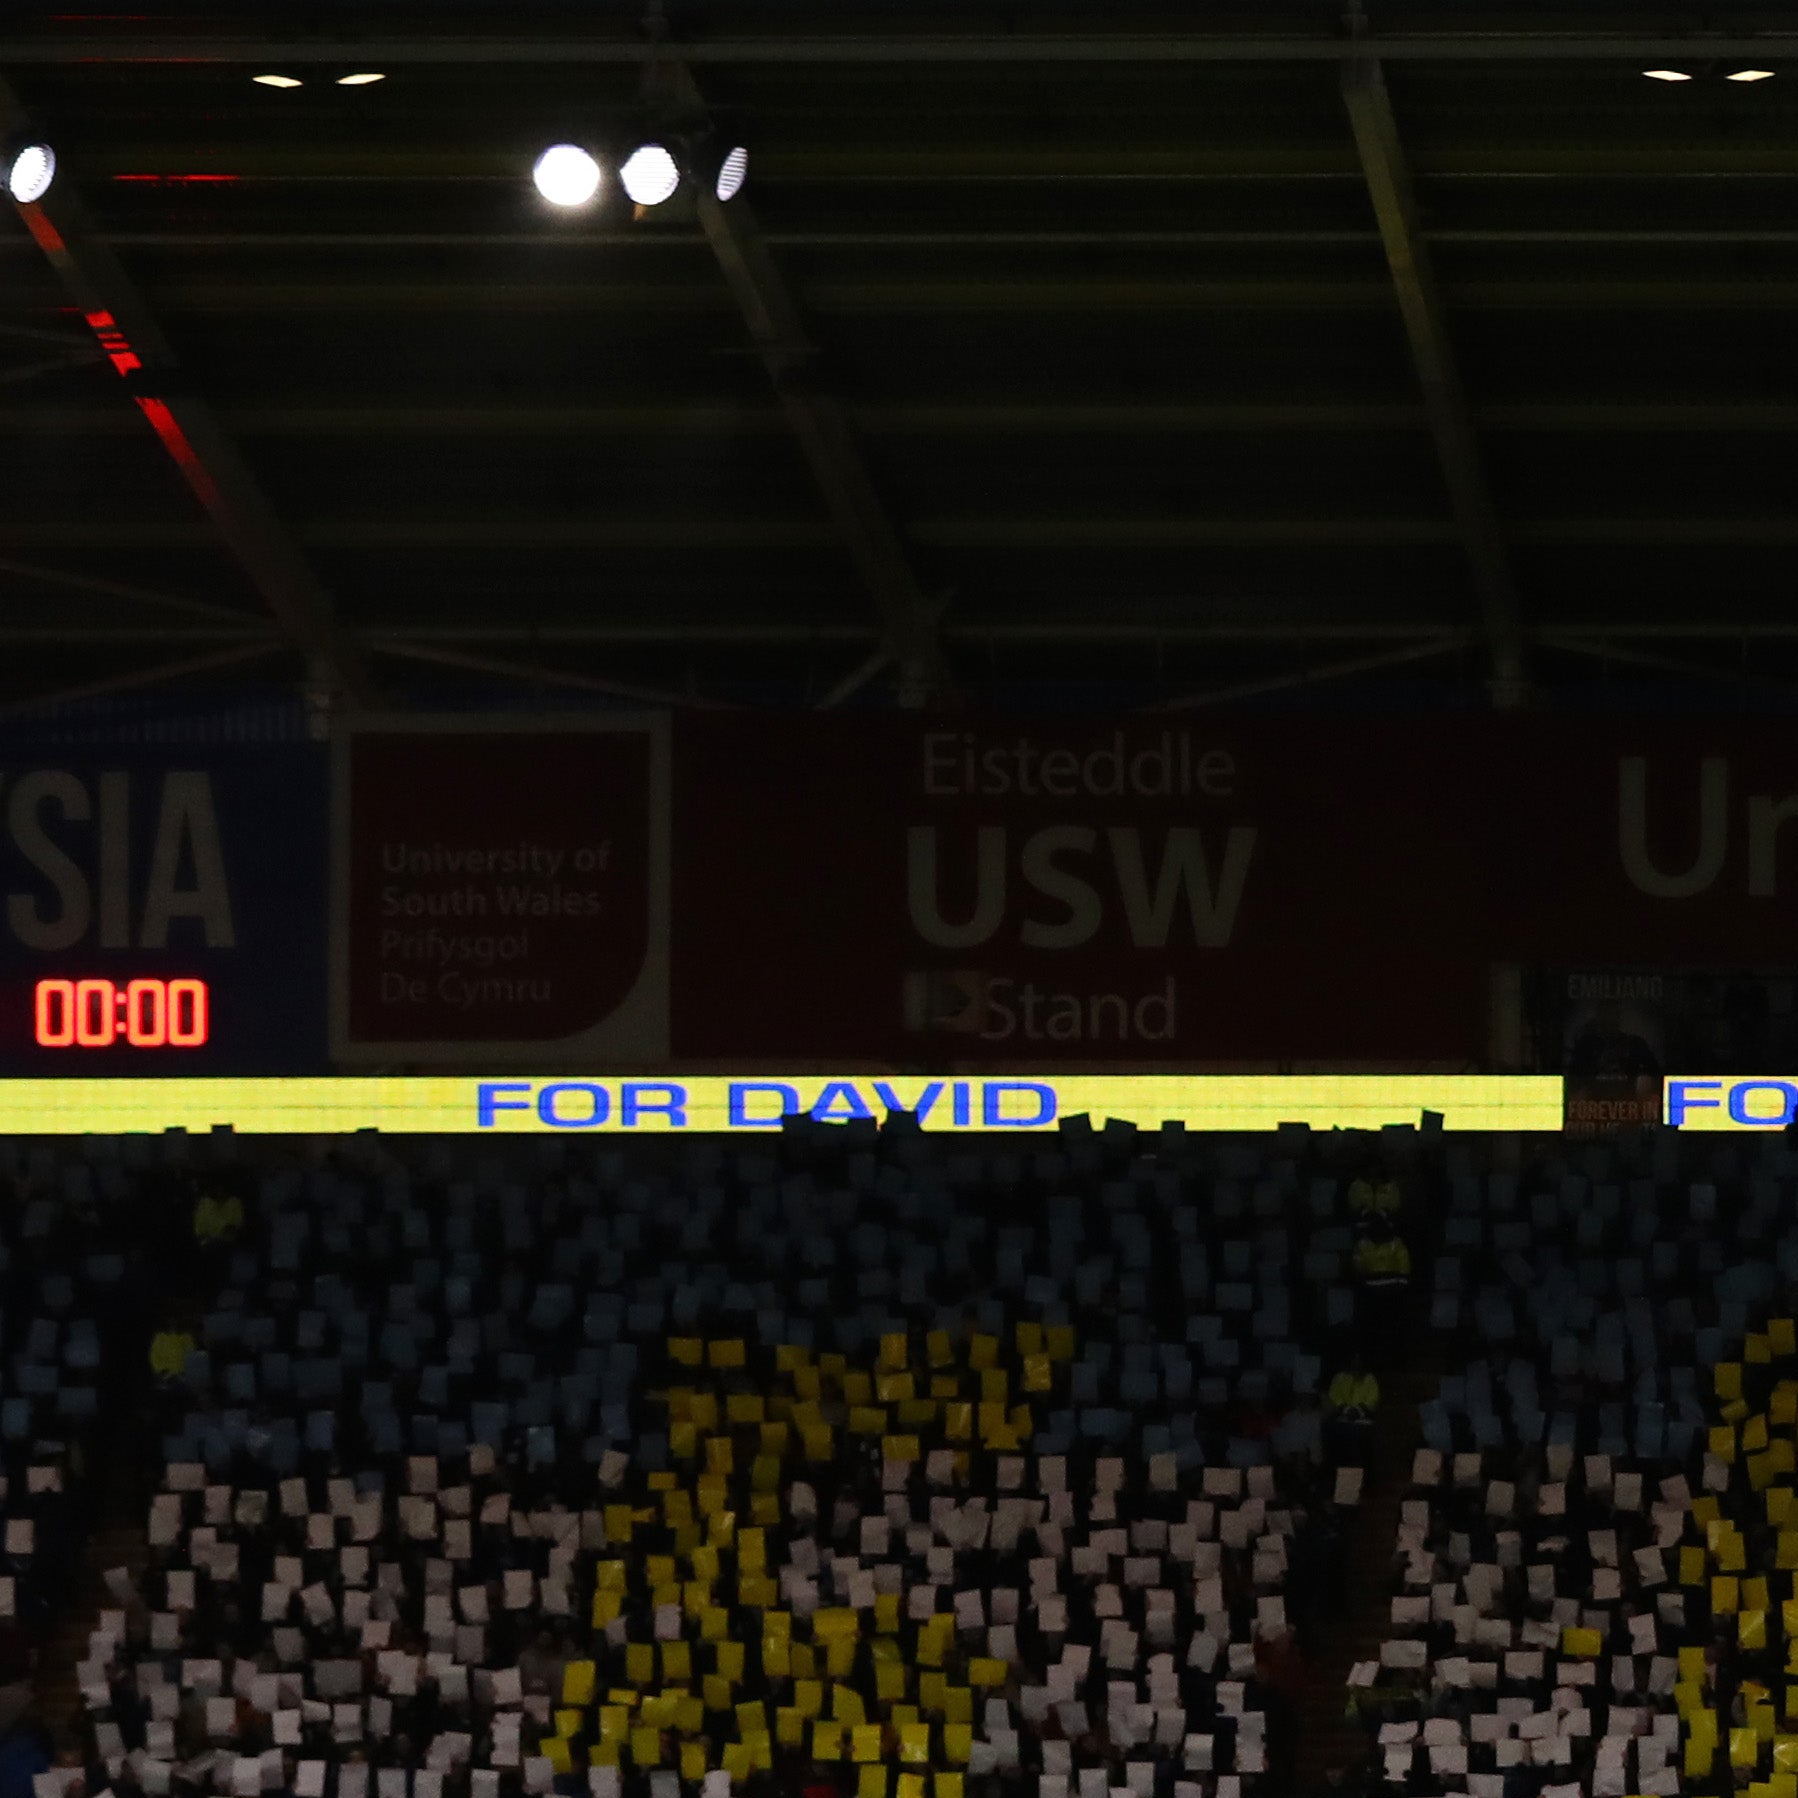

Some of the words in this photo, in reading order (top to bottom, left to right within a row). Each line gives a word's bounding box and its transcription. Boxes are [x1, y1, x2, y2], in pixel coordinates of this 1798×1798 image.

[924, 731, 1236, 798] Eisteddle
[382, 841, 562, 877] University
[576, 839, 611, 873] of
[382, 886, 486, 917] South
[497, 885, 601, 917] Wales
[906, 824, 1258, 950] USW
[382, 929, 528, 963] Prifysgol
[35, 977, 210, 1048] 00:00
[382, 972, 425, 1003] De
[437, 973, 552, 1010] Cymru
[979, 974, 1176, 1042] Stand
[477, 1082, 687, 1127] FOR
[728, 1082, 1058, 1127] DAVID
